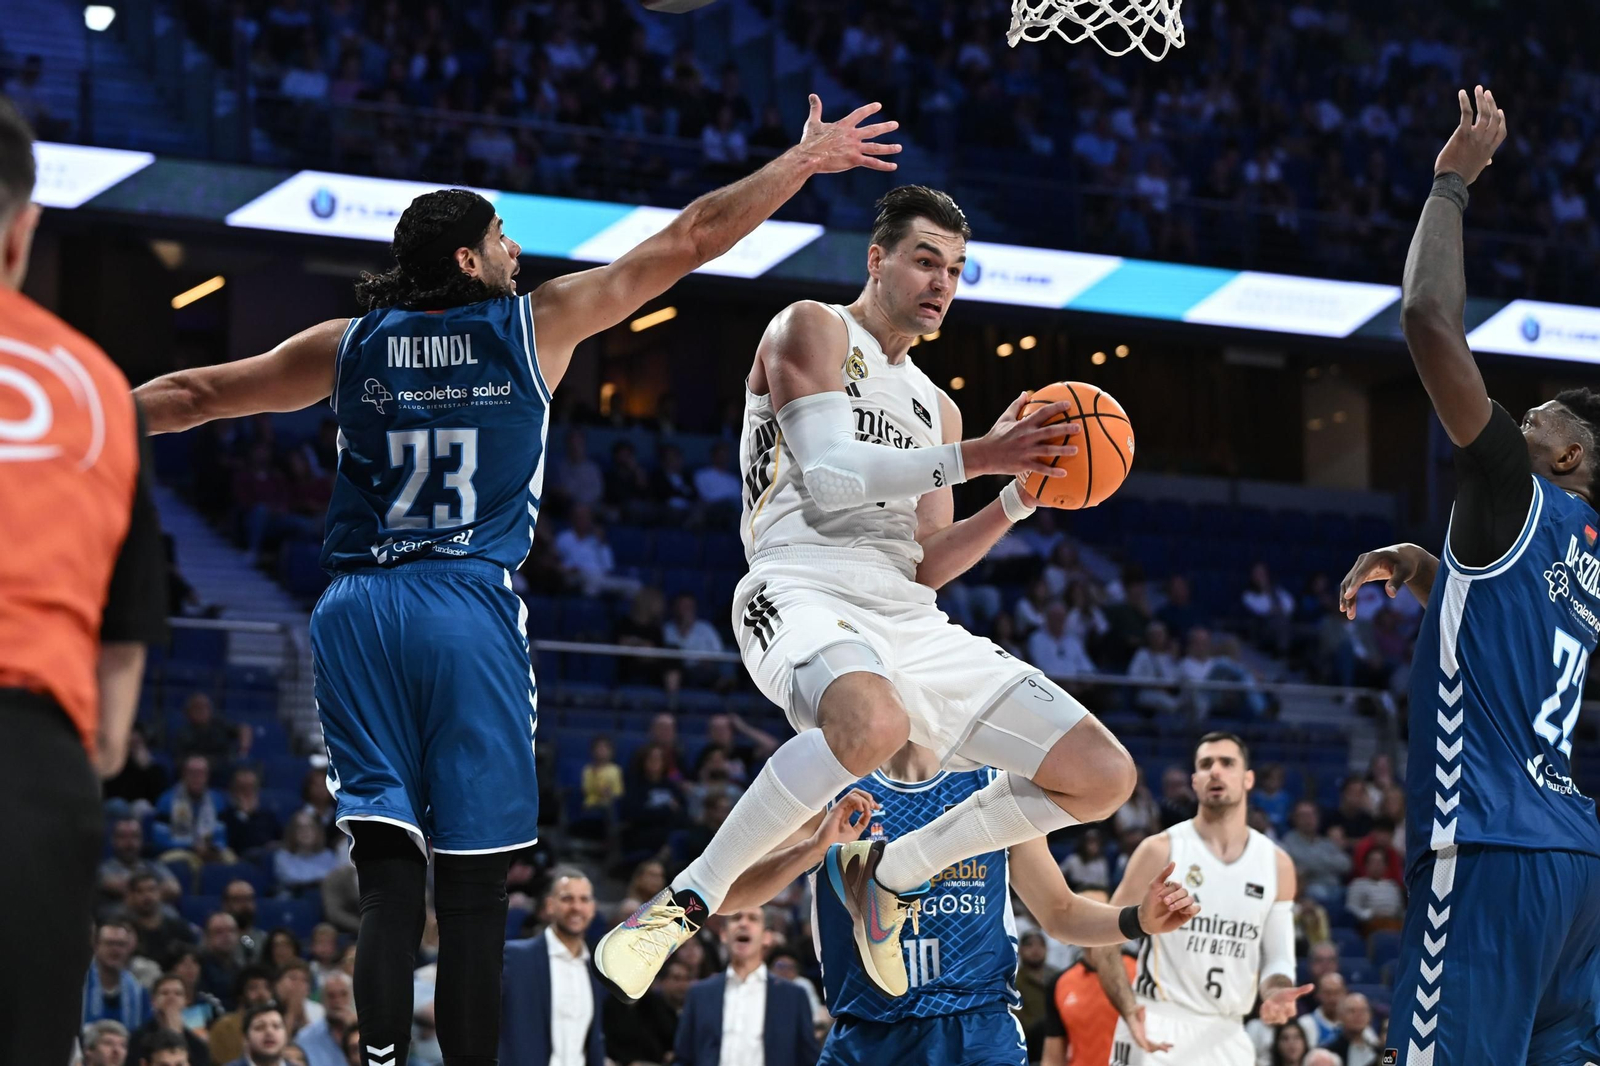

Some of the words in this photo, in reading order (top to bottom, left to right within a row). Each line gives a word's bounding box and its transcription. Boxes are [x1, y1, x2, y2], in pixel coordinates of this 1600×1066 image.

[387, 334, 478, 368] MEINDL
[398, 385, 468, 401] recoletas
[472, 381, 511, 397] salud
[386, 428, 478, 530] 23
[1179, 913, 1260, 940] mirates
[1186, 935, 1207, 953] FLY
[903, 938, 940, 987] 10
[1205, 967, 1224, 1000] 6
